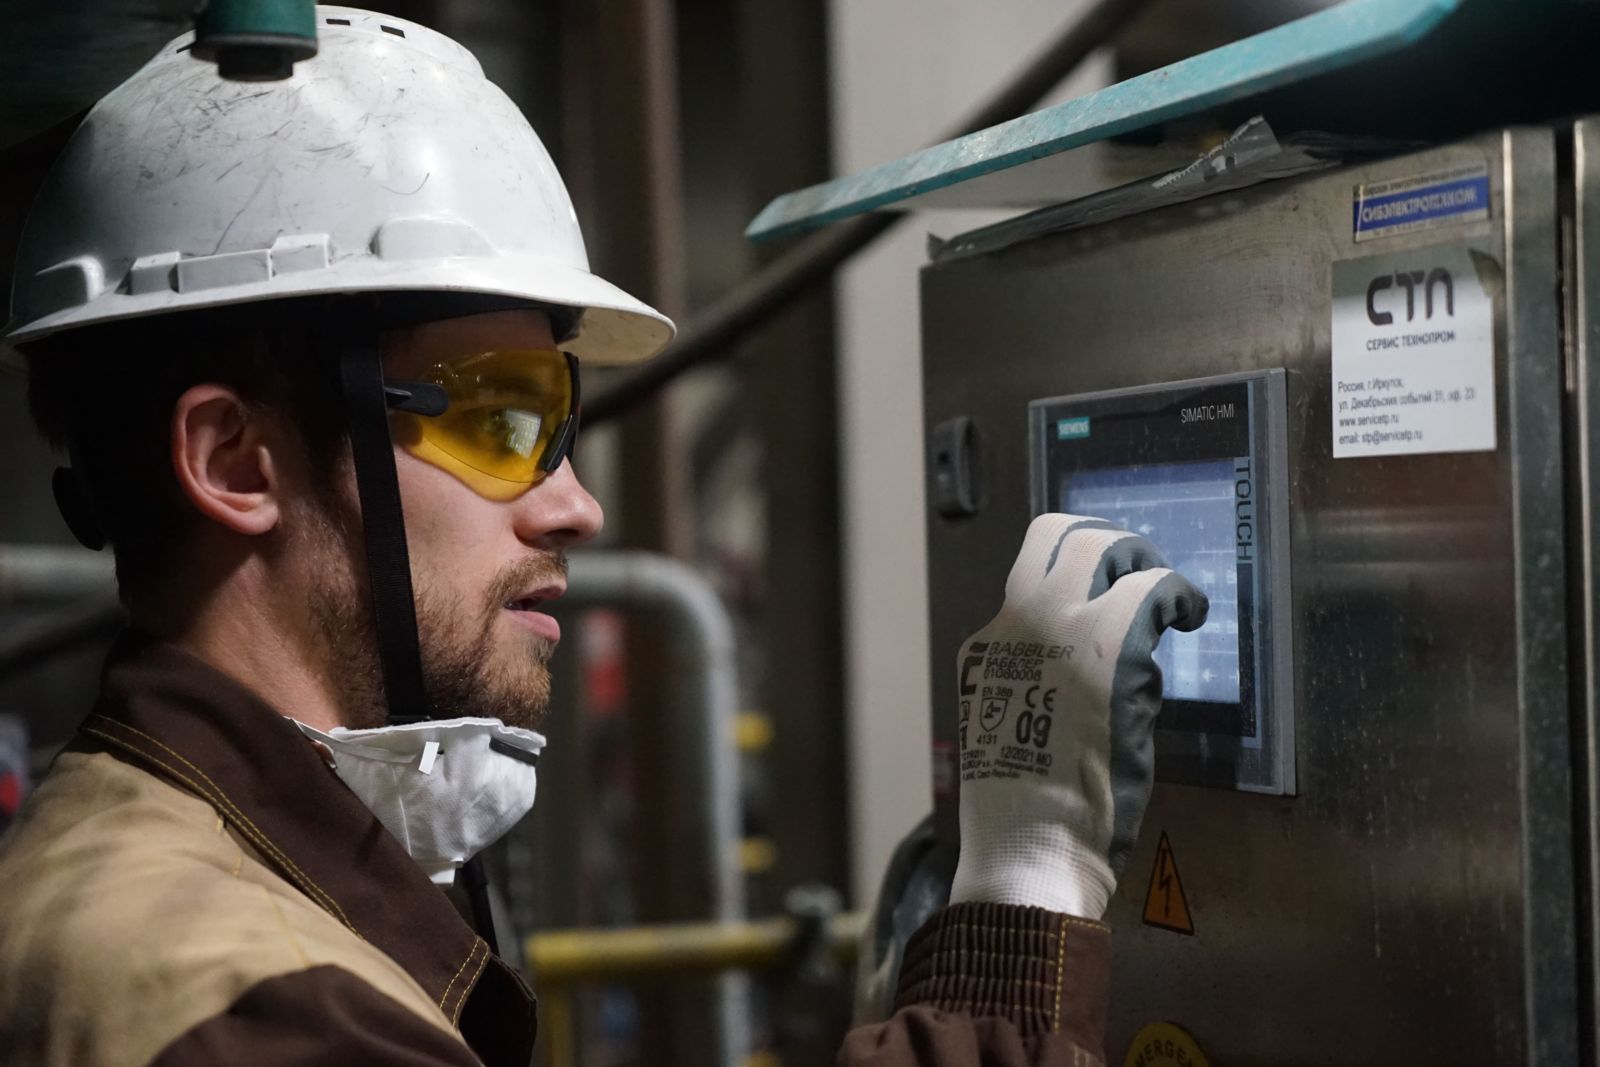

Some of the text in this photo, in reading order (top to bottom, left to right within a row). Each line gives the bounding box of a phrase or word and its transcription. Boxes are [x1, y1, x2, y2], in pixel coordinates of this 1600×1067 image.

[1366, 267, 1454, 326] СТП
[1366, 330, 1456, 351] СЕРВИС ТЕХНОПРОМ
[1180, 403, 1235, 424] SIMATIC HMI
[1059, 421, 1089, 436] SIEMENS
[1235, 459, 1254, 561] TOUCH
[987, 641, 1075, 659] BABBLER
[985, 656, 1044, 669] БАББЛЕР
[983, 668, 1043, 681] 01080008
[982, 686, 994, 698] EN
[1016, 710, 1052, 749] 09
[977, 734, 998, 745] 4131
[1001, 745, 1034, 763] 12/2021
